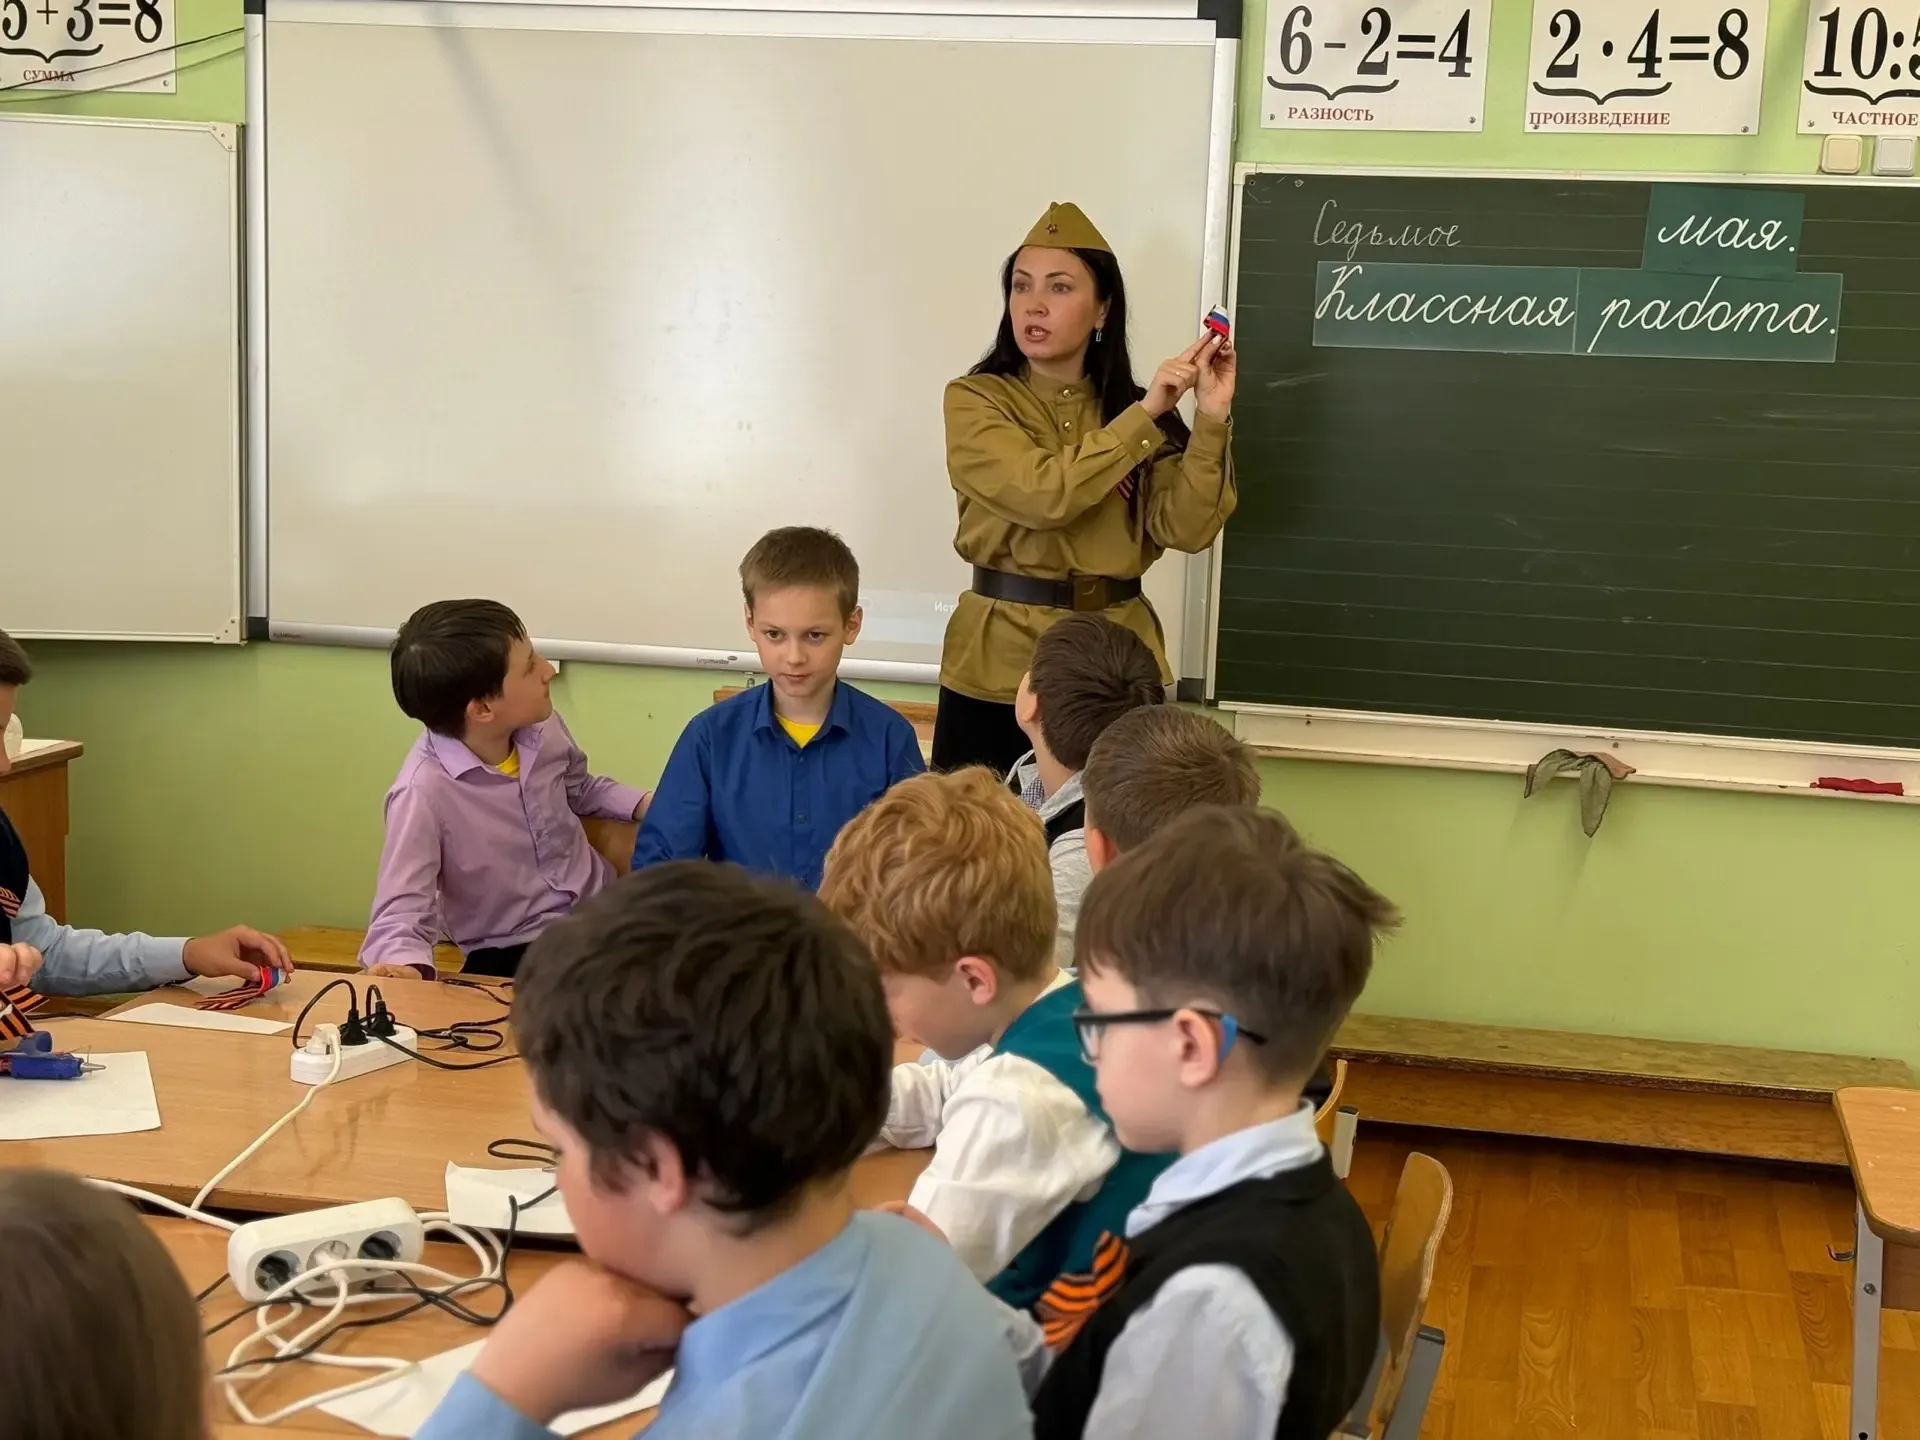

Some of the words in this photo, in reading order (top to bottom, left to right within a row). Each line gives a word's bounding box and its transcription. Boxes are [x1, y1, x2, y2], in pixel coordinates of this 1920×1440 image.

[23, 70, 76, 82] СУММА
[1287, 106, 1374, 122] РАЗНОСТЬ
[1529, 111, 1671, 127] ПРОИЗВЕДЕНИЕ
[1832, 111, 1919, 126] ЧАСТНОЕ
[1313, 199, 1461, 262] Седьмое
[1656, 213, 1797, 253] мая.
[1314, 264, 1576, 327] Классная
[1586, 275, 1837, 354] работа.
